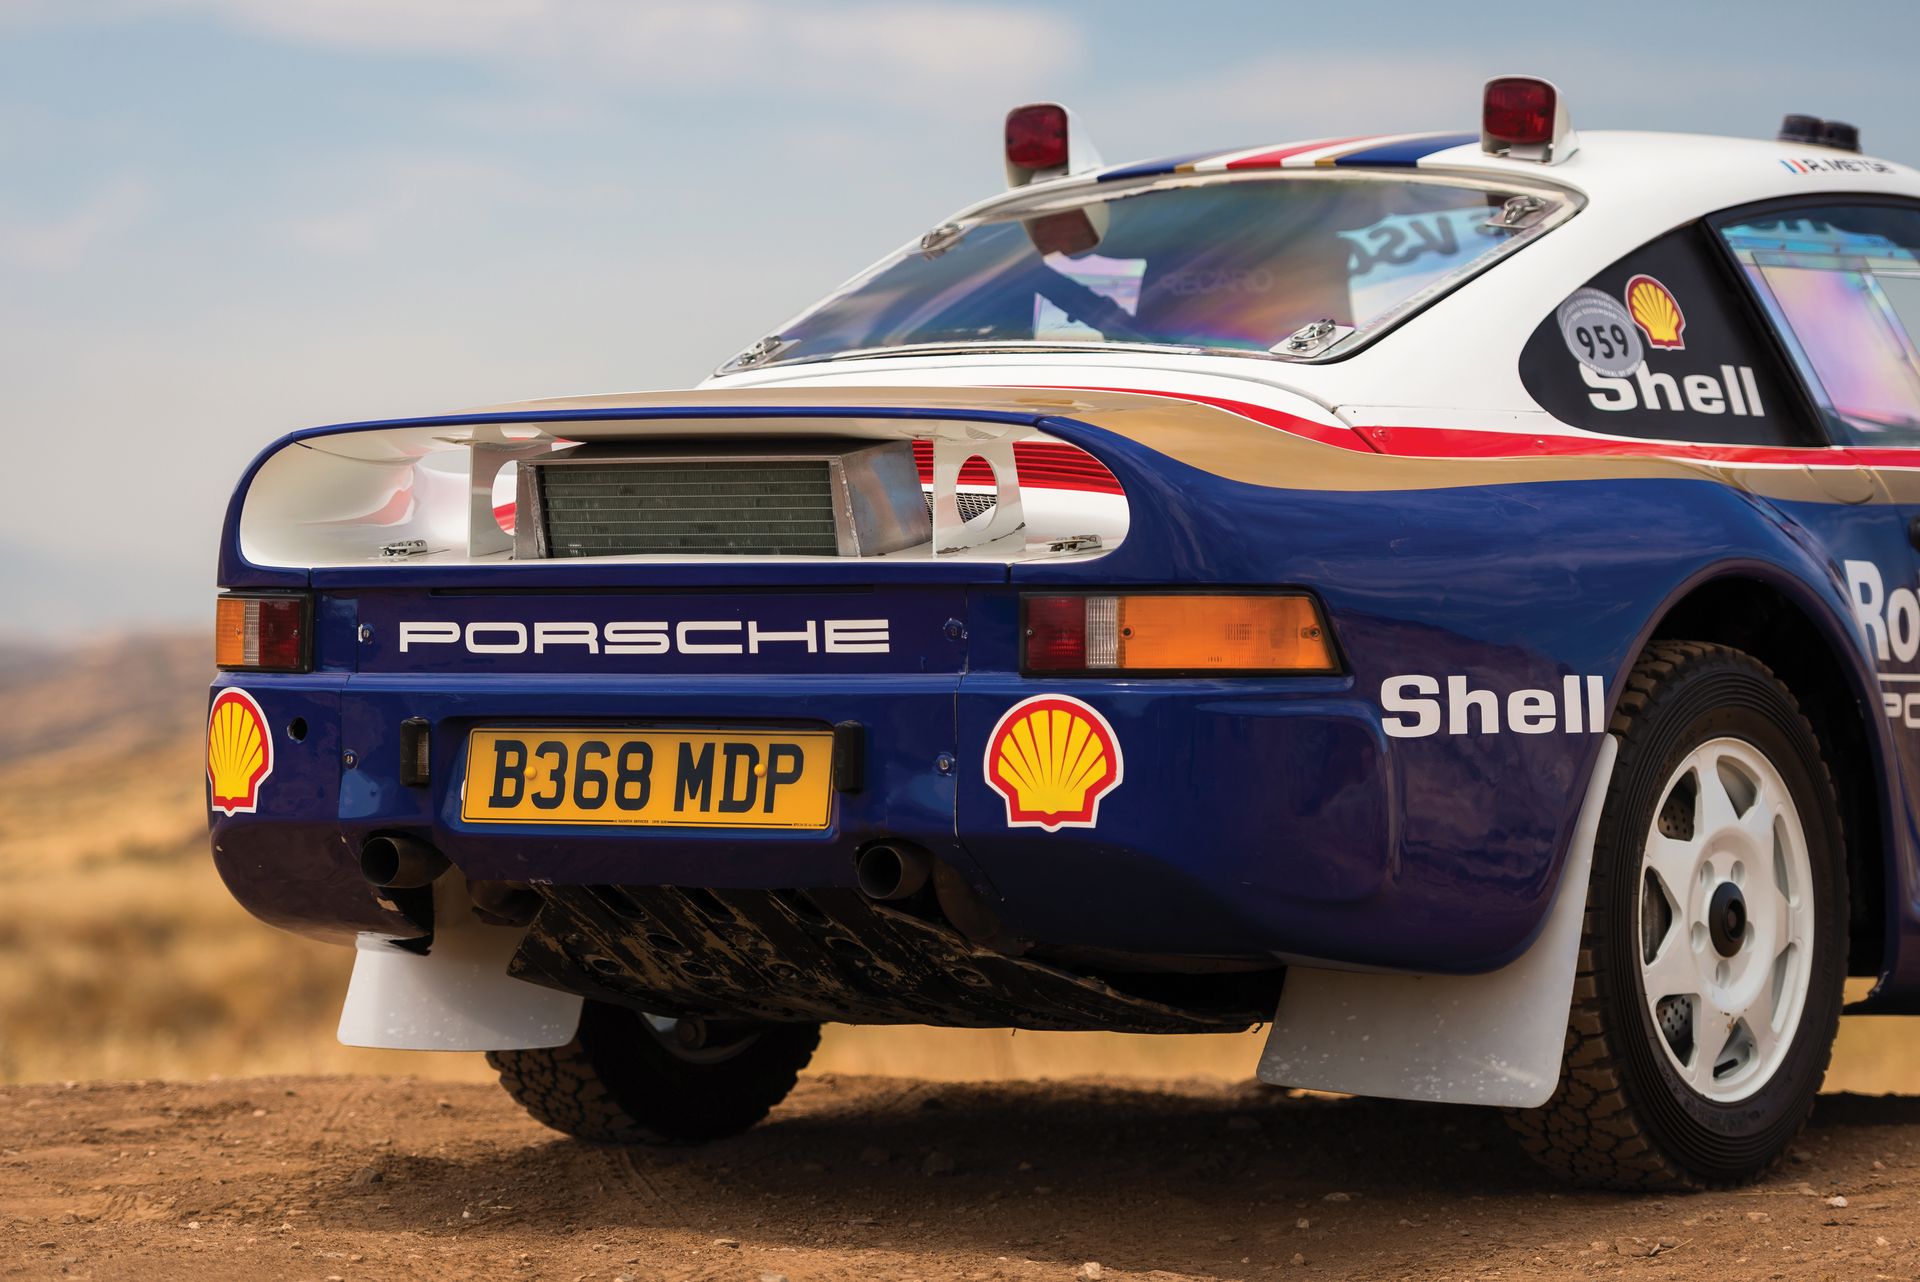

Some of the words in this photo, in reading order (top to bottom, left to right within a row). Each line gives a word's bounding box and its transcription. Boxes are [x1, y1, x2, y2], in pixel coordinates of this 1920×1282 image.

[1576, 324, 1629, 360] 959
[1578, 360, 1765, 417] Shell
[399, 619, 890, 654] PORSCHE
[1844, 559, 1920, 664] Ro
[1381, 674, 1605, 738] Shell
[487, 739, 654, 811] B368
[674, 742, 805, 814] MDP
